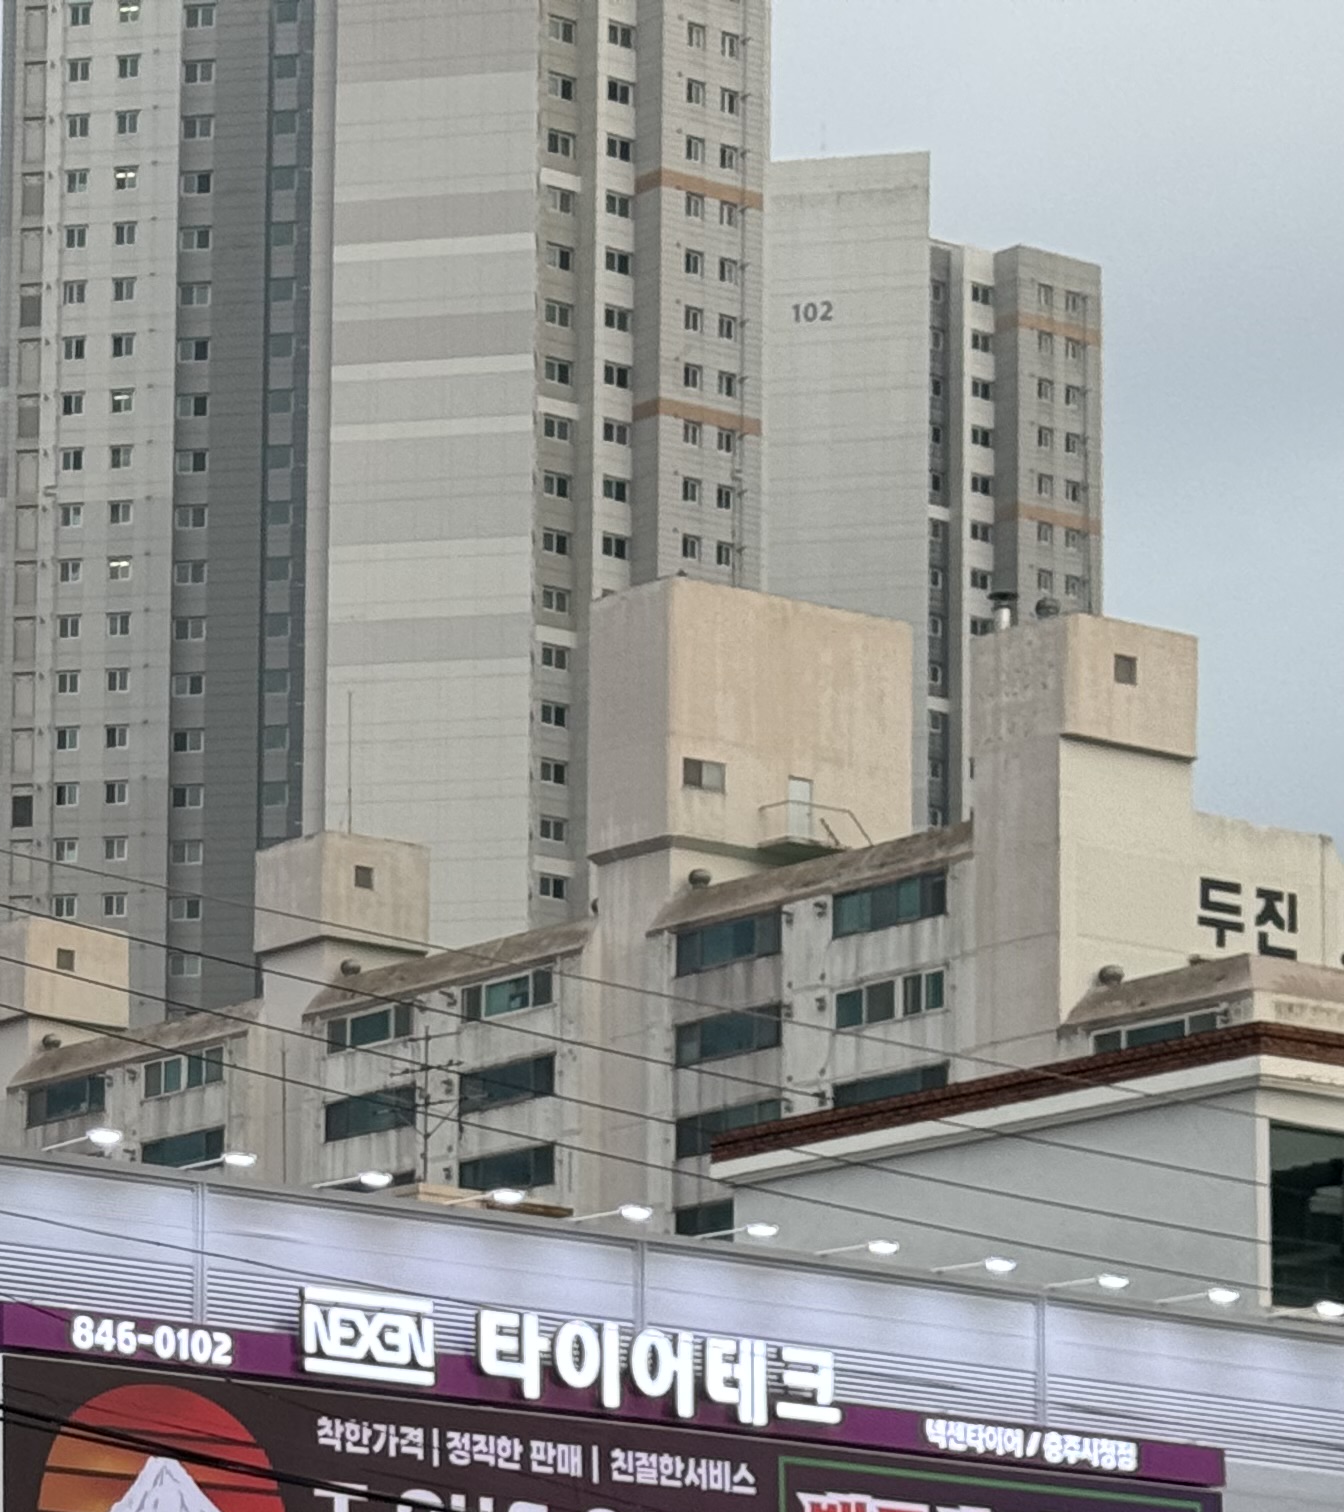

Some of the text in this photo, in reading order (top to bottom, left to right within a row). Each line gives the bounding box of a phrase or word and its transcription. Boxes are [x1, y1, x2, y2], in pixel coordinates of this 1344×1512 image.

[791, 299, 834, 324] 102
[1197, 876, 1299, 961] 두진
[71, 1313, 234, 1367] 846-0102
[300, 1302, 843, 1426] NEXEN 타이어테크
[316, 1415, 758, 1496] 착한가격 정직한 판매 친절한서비스
[925, 1418, 1025, 1459] 넥센타이어
